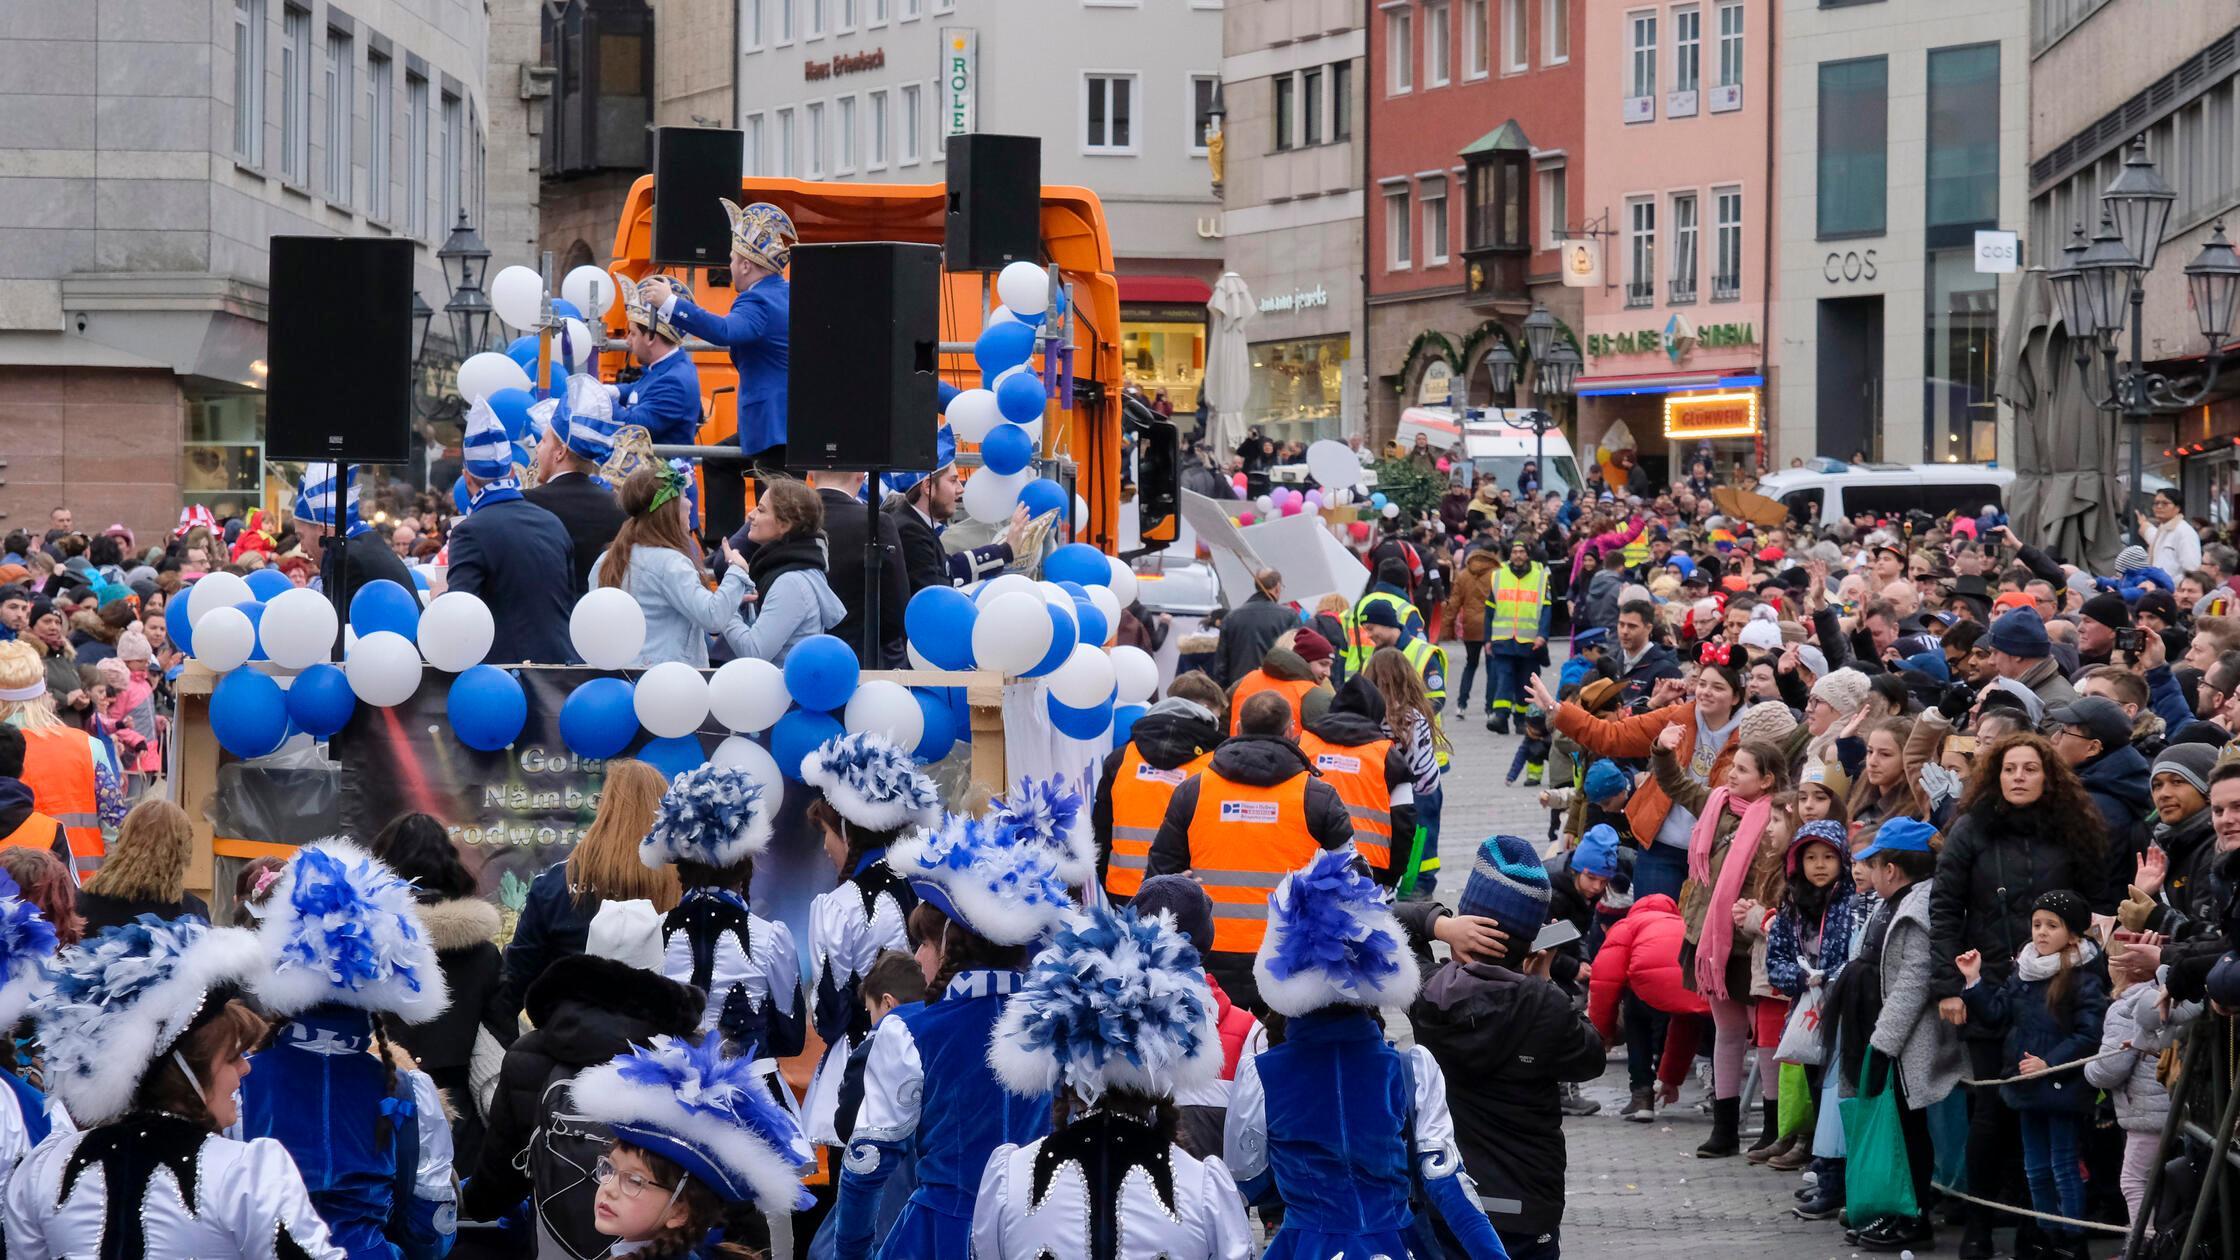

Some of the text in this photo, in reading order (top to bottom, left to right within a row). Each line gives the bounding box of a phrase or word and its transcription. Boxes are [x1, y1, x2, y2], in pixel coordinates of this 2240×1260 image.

[951, 57, 967, 134] ROLE
[1824, 249, 1877, 284] COS
[1981, 246, 2013, 259] COS
[1697, 322, 1754, 348] SIRENA
